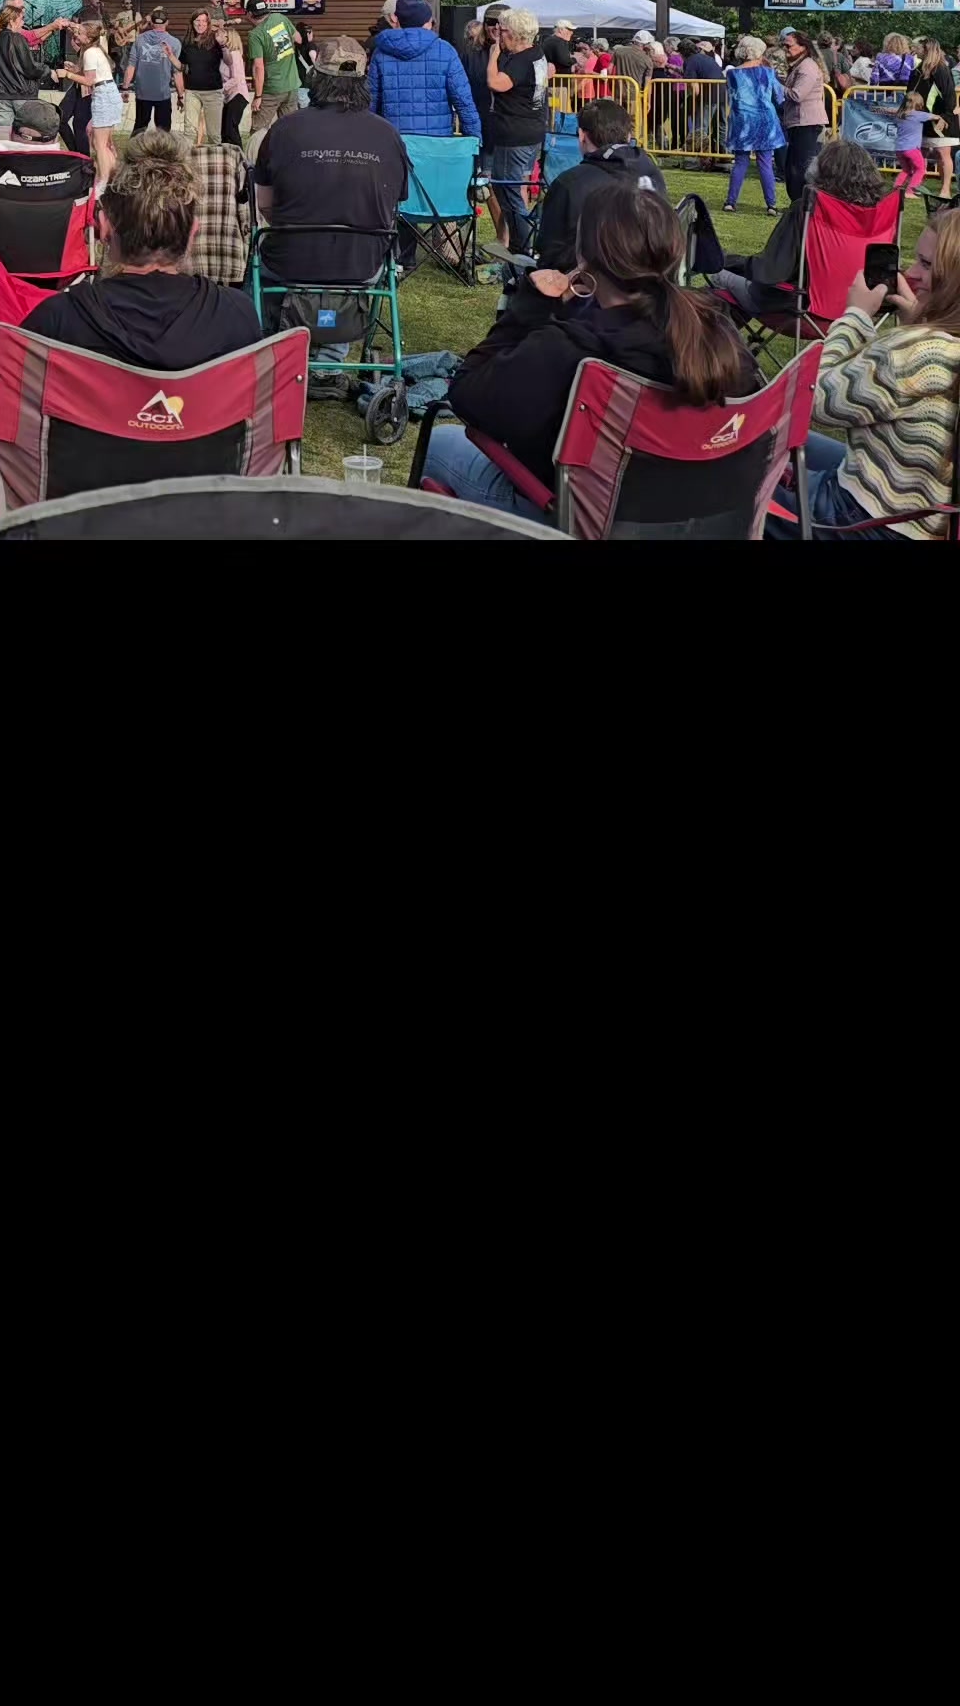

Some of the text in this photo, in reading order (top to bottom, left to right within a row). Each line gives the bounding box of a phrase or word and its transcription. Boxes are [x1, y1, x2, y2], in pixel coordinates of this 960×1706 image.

[300, 150, 341, 158] SERVICE
[343, 150, 381, 163] ALASKA
[136, 412, 174, 423] GCI
[710, 432, 735, 443] GCI
